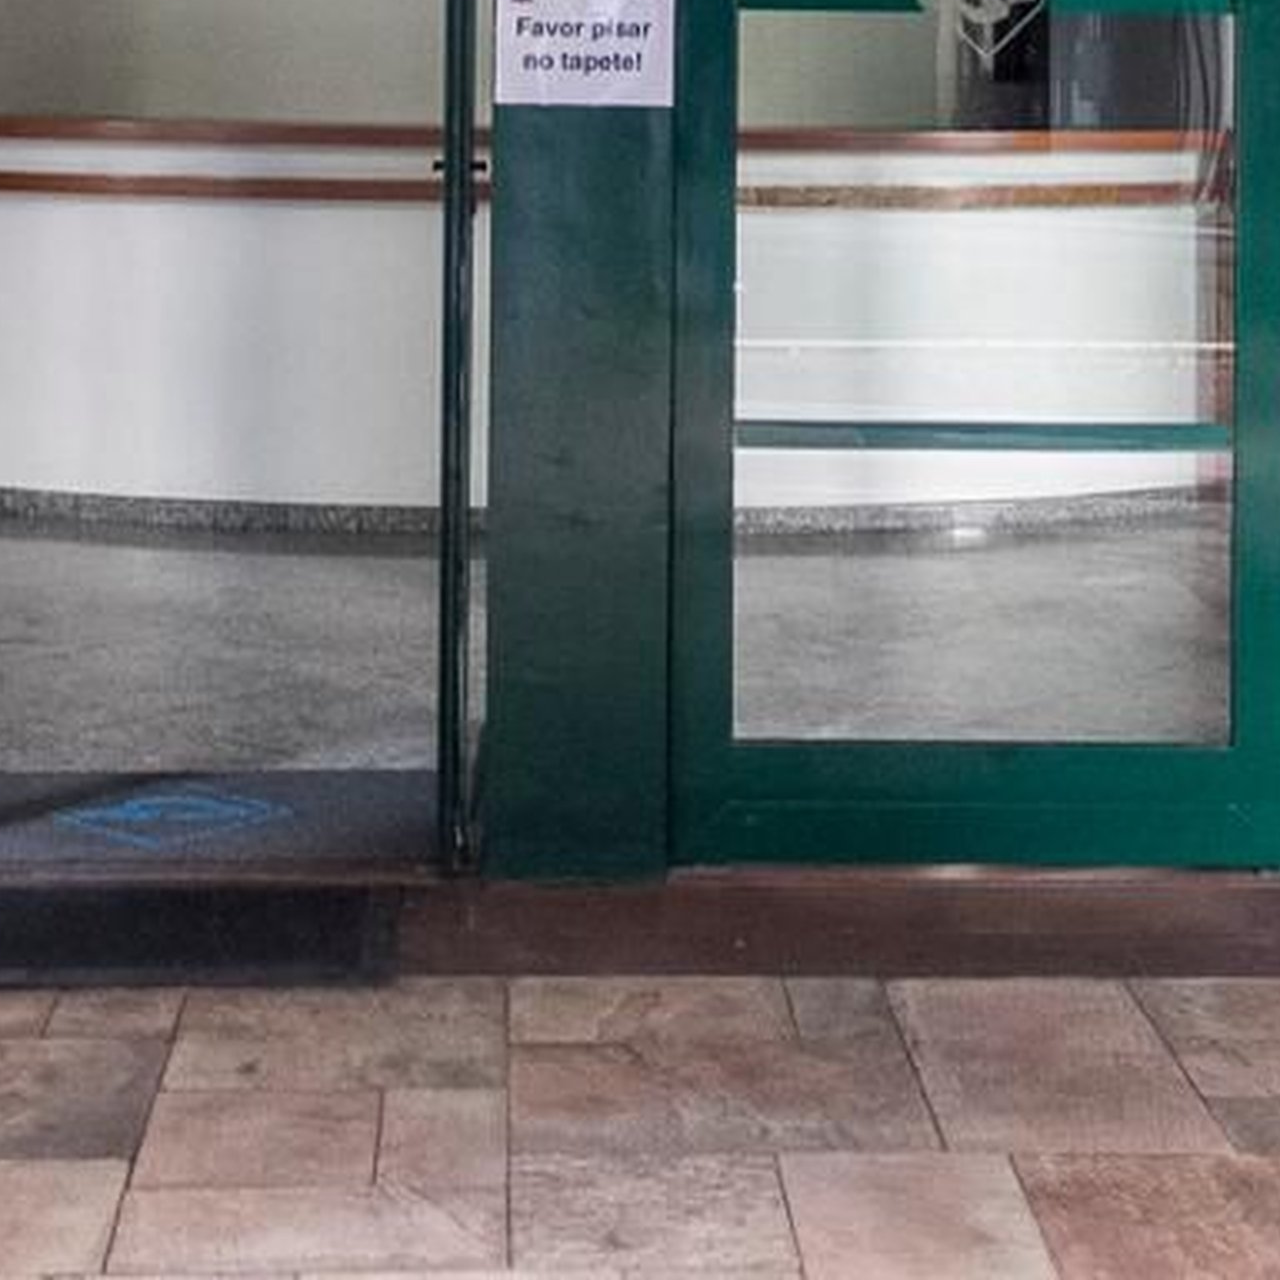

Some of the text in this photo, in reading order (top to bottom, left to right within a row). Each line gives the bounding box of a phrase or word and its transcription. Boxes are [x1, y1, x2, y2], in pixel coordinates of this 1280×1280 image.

[515, 16, 652, 41] Favor pisar
[523, 52, 642, 75] no tapete!
